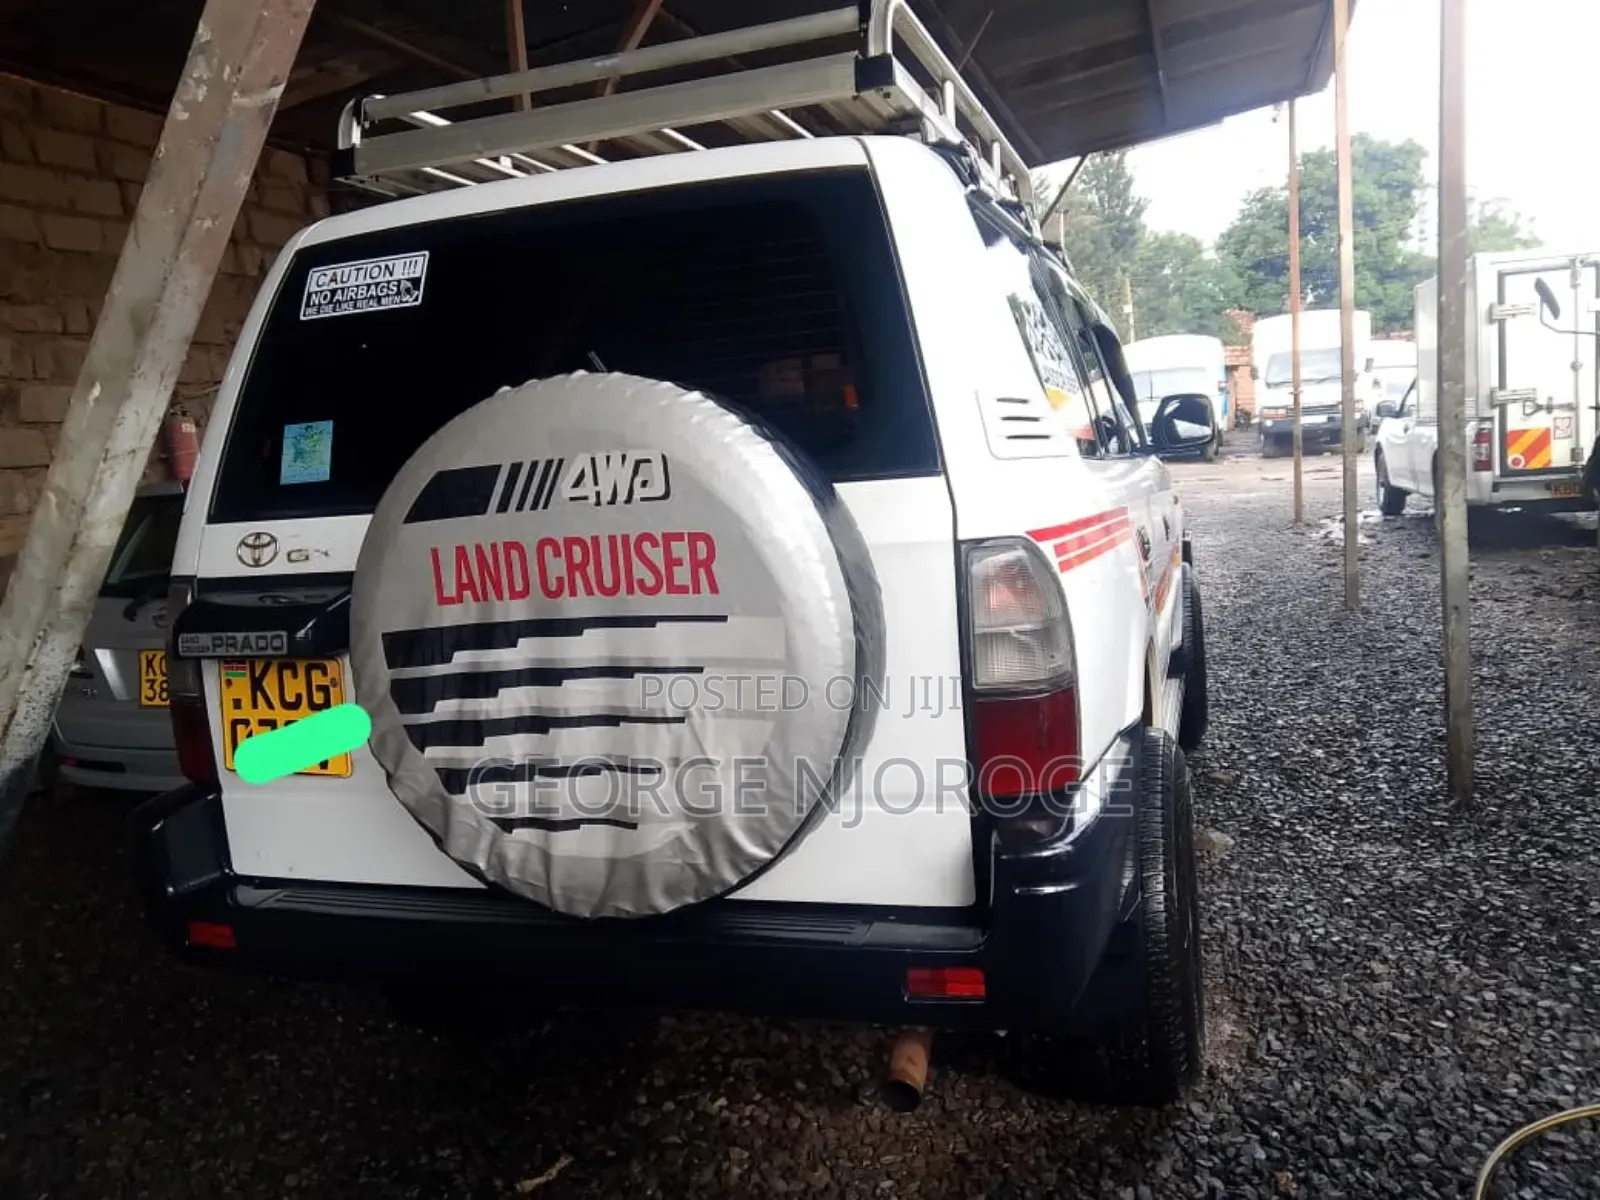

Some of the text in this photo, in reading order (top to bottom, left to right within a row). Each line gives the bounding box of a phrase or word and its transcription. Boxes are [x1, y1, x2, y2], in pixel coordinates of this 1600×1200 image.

[315, 259, 418, 288] CAUTION !!!
[305, 295, 401, 316] WE DIE LIKE REAL MEN
[310, 281, 398, 306] NO AIRBAGS
[561, 450, 671, 507] 4WD
[430, 531, 720, 607] LAND CRUISER
[211, 633, 284, 653] PRADO
